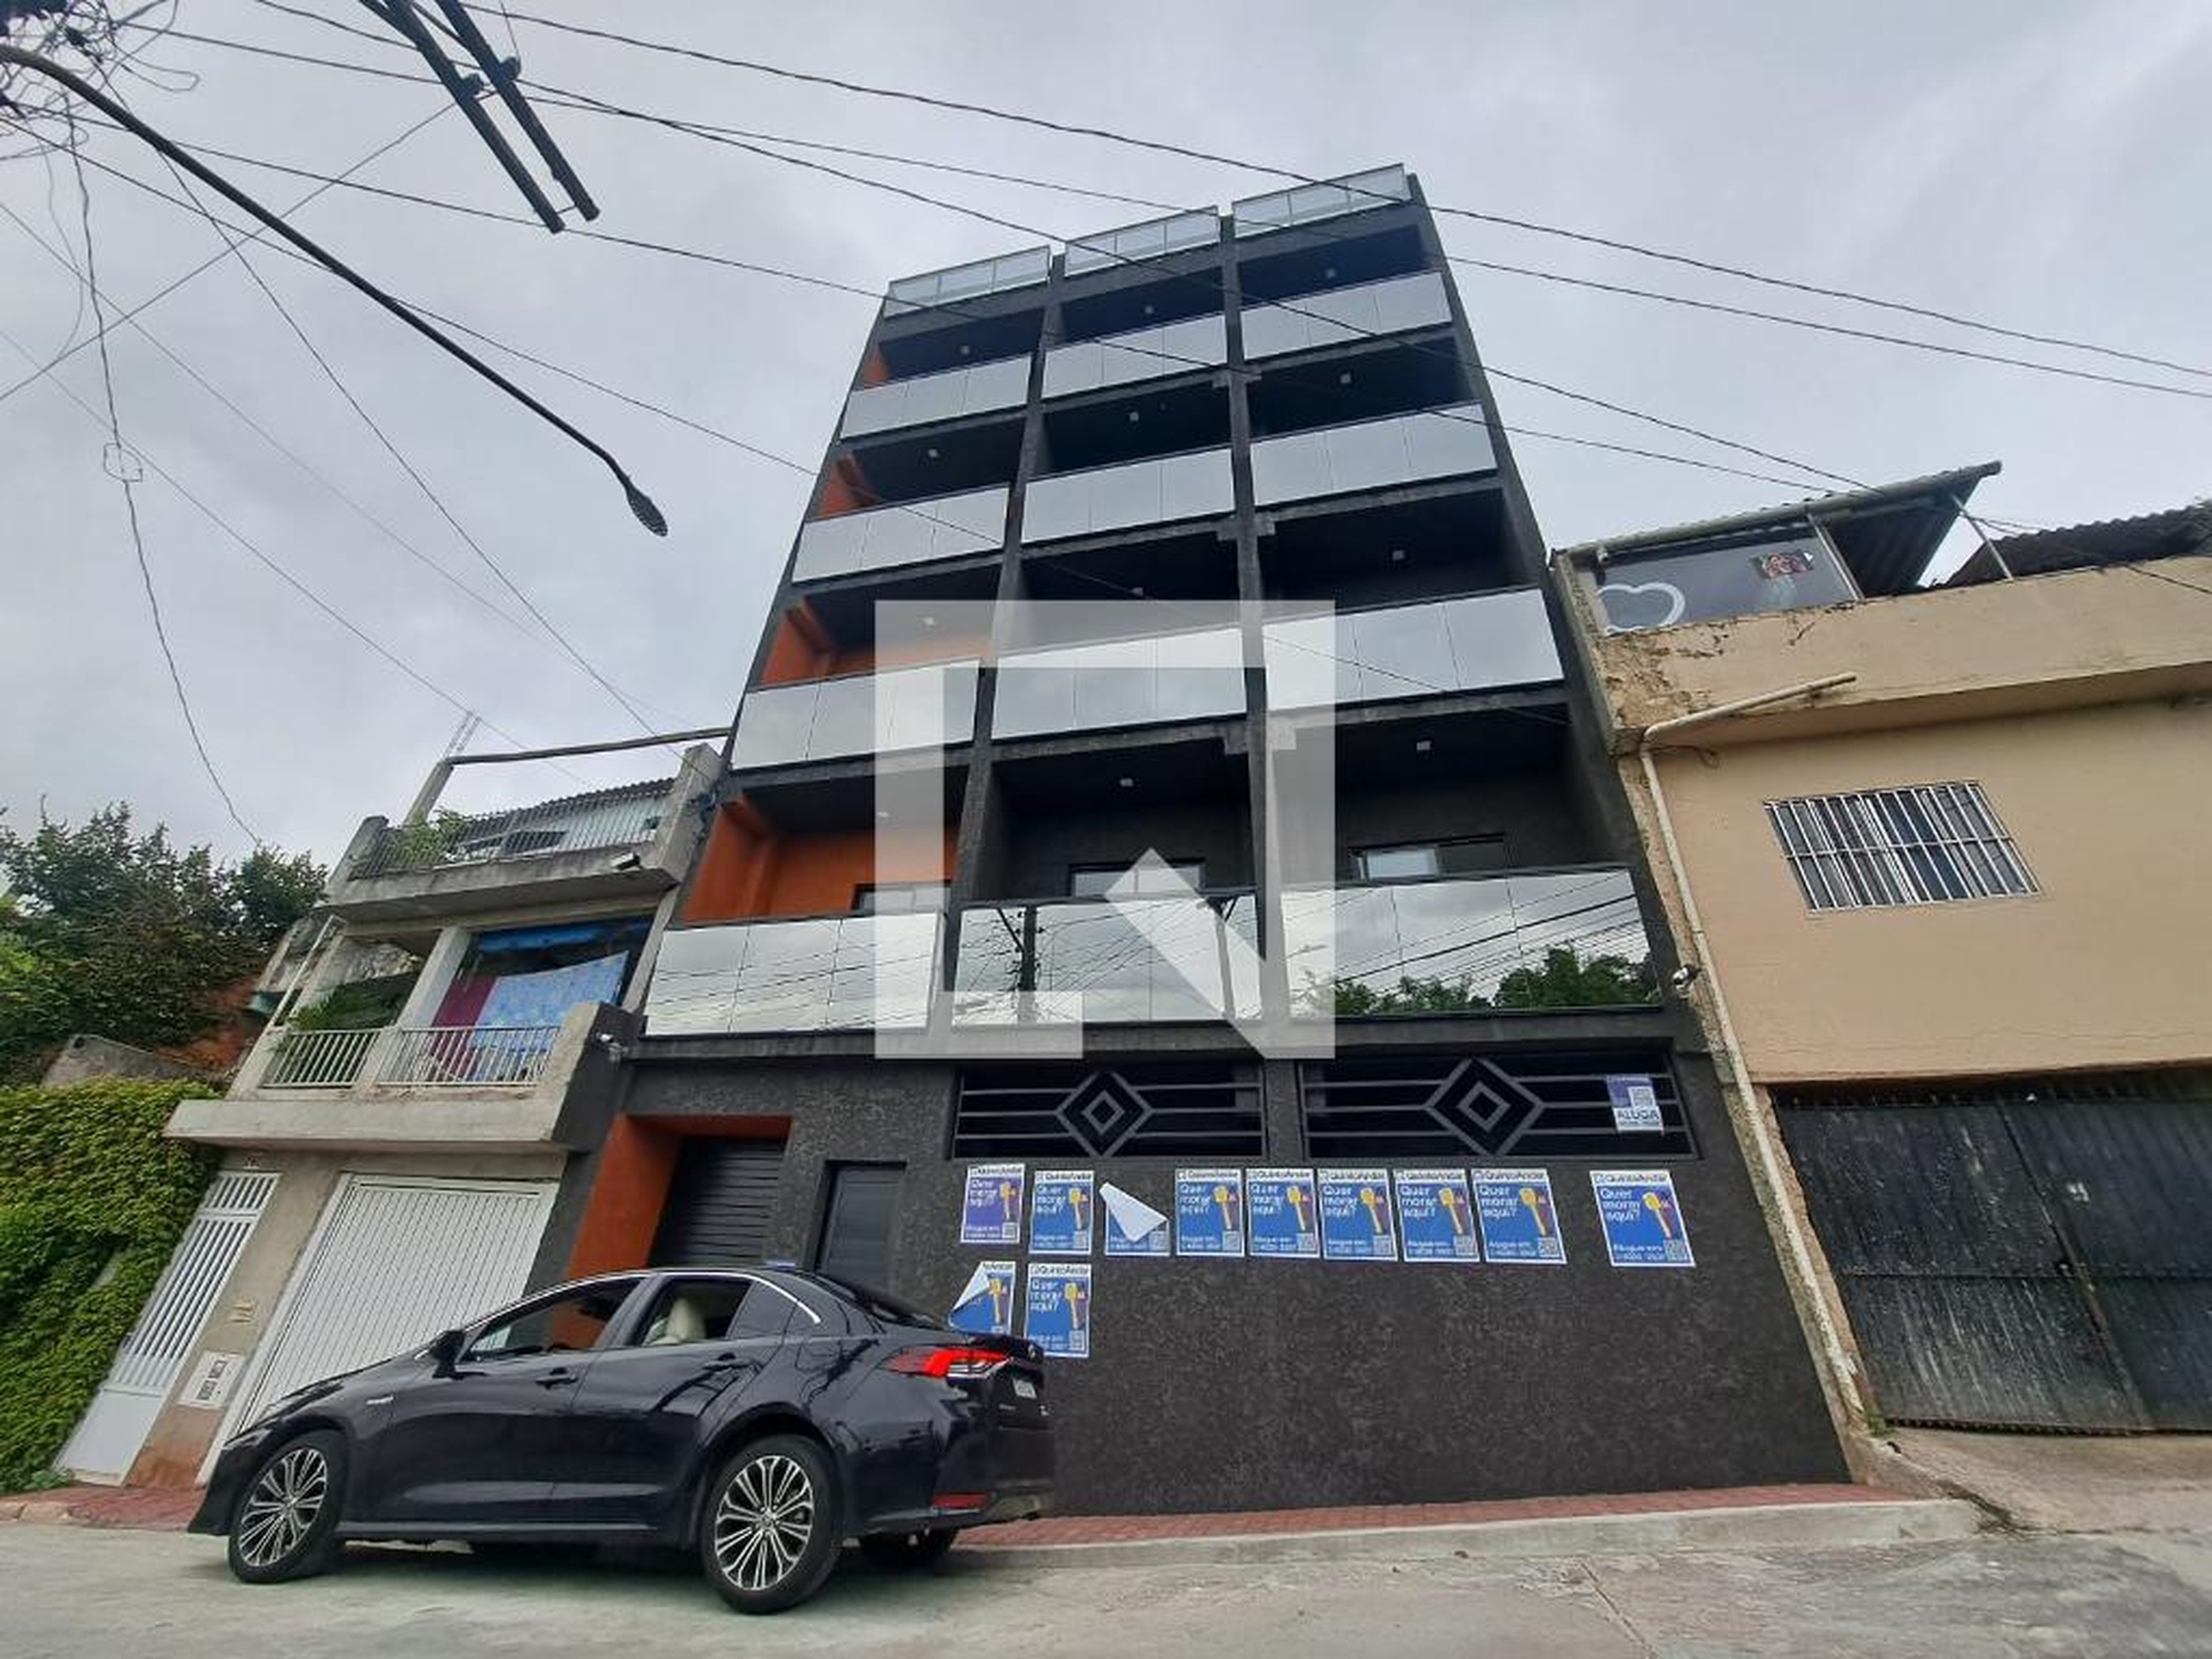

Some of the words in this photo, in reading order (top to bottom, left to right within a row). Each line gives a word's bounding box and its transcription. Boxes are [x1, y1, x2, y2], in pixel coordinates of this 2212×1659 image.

[1324, 1185, 1352, 1195] Quer
[1400, 1185, 1430, 1196] Quer
[1479, 1185, 1510, 1196] Quer
[1600, 1187, 1633, 1199] Quer
[1402, 1198, 1438, 1206] morar
[1481, 1198, 1519, 1206] morar
